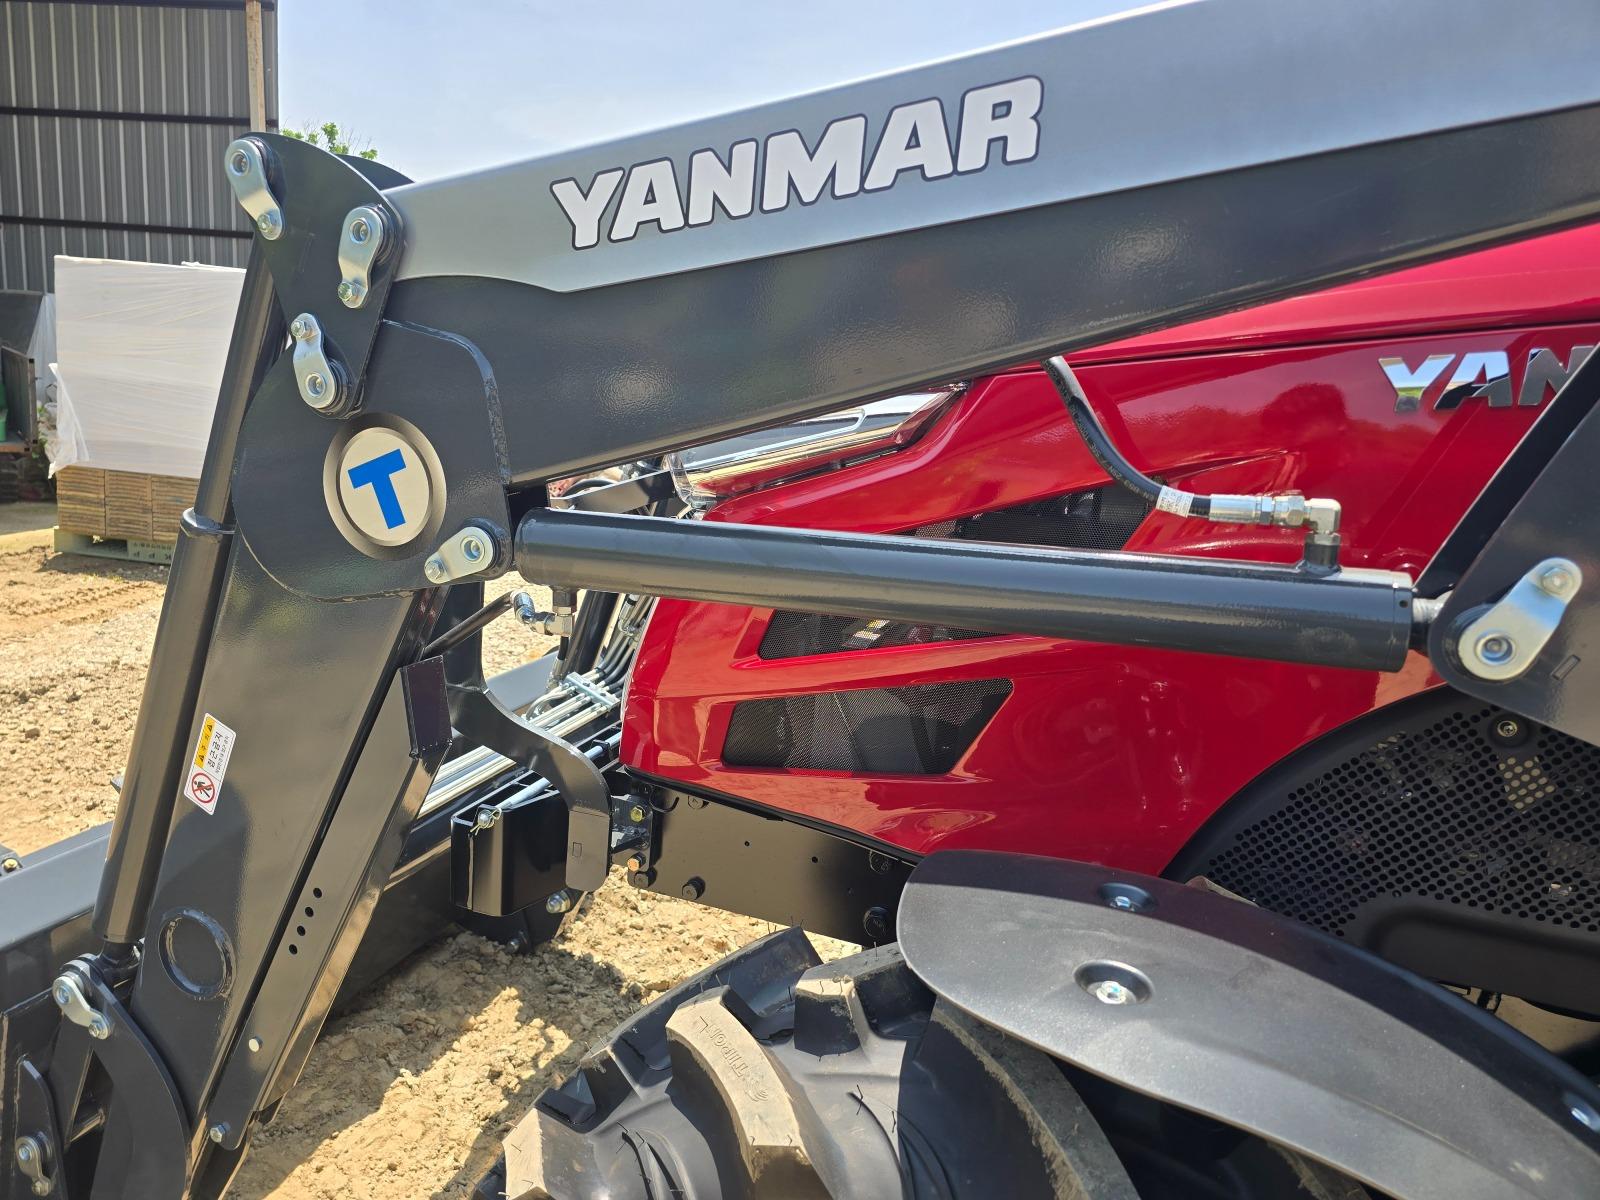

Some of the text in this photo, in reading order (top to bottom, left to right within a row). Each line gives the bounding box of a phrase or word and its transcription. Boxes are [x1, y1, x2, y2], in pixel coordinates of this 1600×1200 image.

[550, 76, 1044, 250] YANMAR
[1378, 345, 1595, 412] YAN
[348, 448, 406, 529] T
[208, 731, 223, 768] 접근금지
